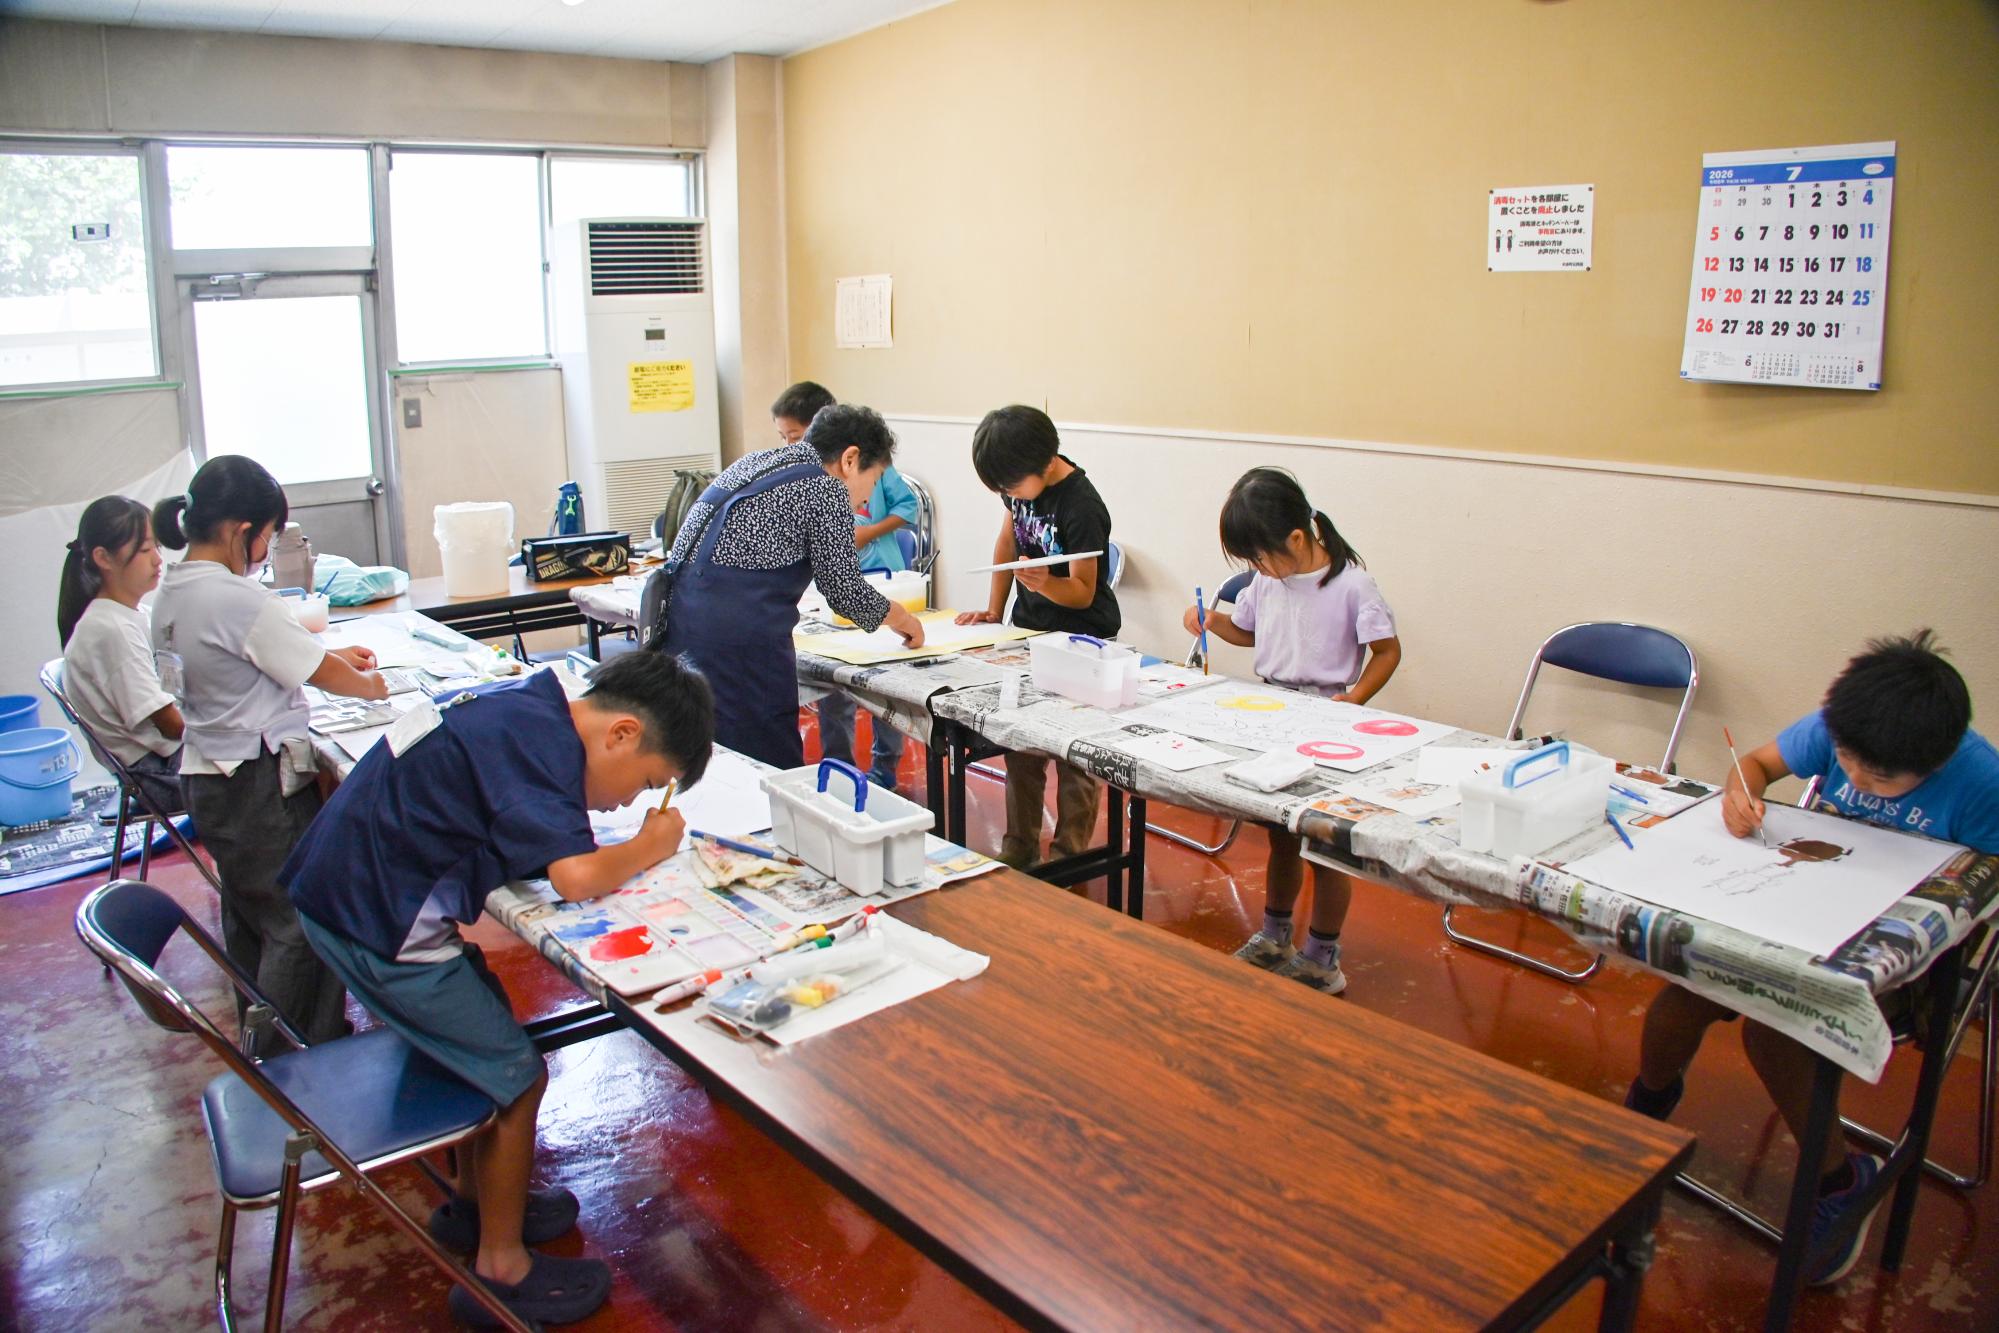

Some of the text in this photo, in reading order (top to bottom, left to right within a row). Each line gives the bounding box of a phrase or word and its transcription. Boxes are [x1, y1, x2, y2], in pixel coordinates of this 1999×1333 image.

[1709, 166, 1802, 181] 2026 7
[1494, 193, 1569, 205] 消毒セットを各部屋に
[1738, 198, 1747, 206] 29
[1762, 198, 1772, 206] 30
[1789, 193, 1795, 208] 1
[1811, 192, 1822, 207] 2
[1837, 190, 1847, 206] 3
[1862, 189, 1873, 205] 4
[1501, 204, 1584, 215] 置くことを廃止しました
[1710, 223, 1874, 240] 5 6 7 8 9 10 11
[1704, 257, 1872, 272] 12 13 14 15 16 17 18
[1701, 288, 1870, 306] 19 20 21 22 23 24 25
[1696, 318, 1713, 333] 26
[1721, 320, 1738, 334] 27
[1746, 320, 1763, 335] 28
[1771, 321, 1789, 336] 29
[1797, 322, 1816, 337] 30
[1824, 323, 1840, 338] 31
[1834, 782, 1900, 816] ALWAYS
[1906, 807, 1933, 831] BE
